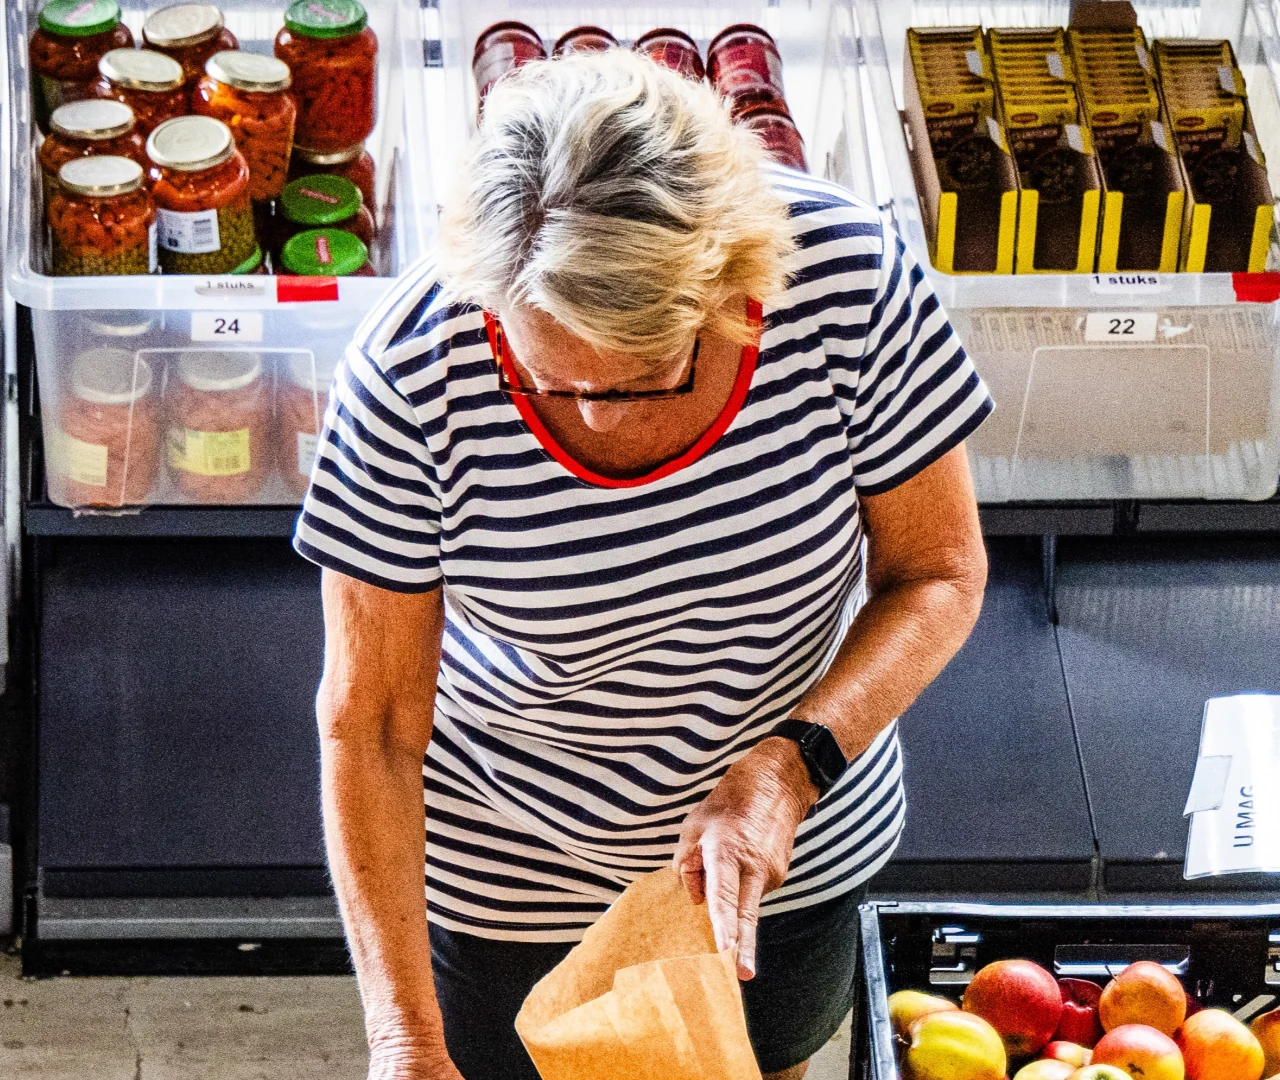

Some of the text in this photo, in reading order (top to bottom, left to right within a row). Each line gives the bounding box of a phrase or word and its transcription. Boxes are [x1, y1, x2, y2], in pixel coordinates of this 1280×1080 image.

[217, 281, 255, 289] stuks
[1093, 276, 1158, 285] 1 stuks
[214, 318, 240, 334] 24
[1108, 318, 1136, 335] 22
